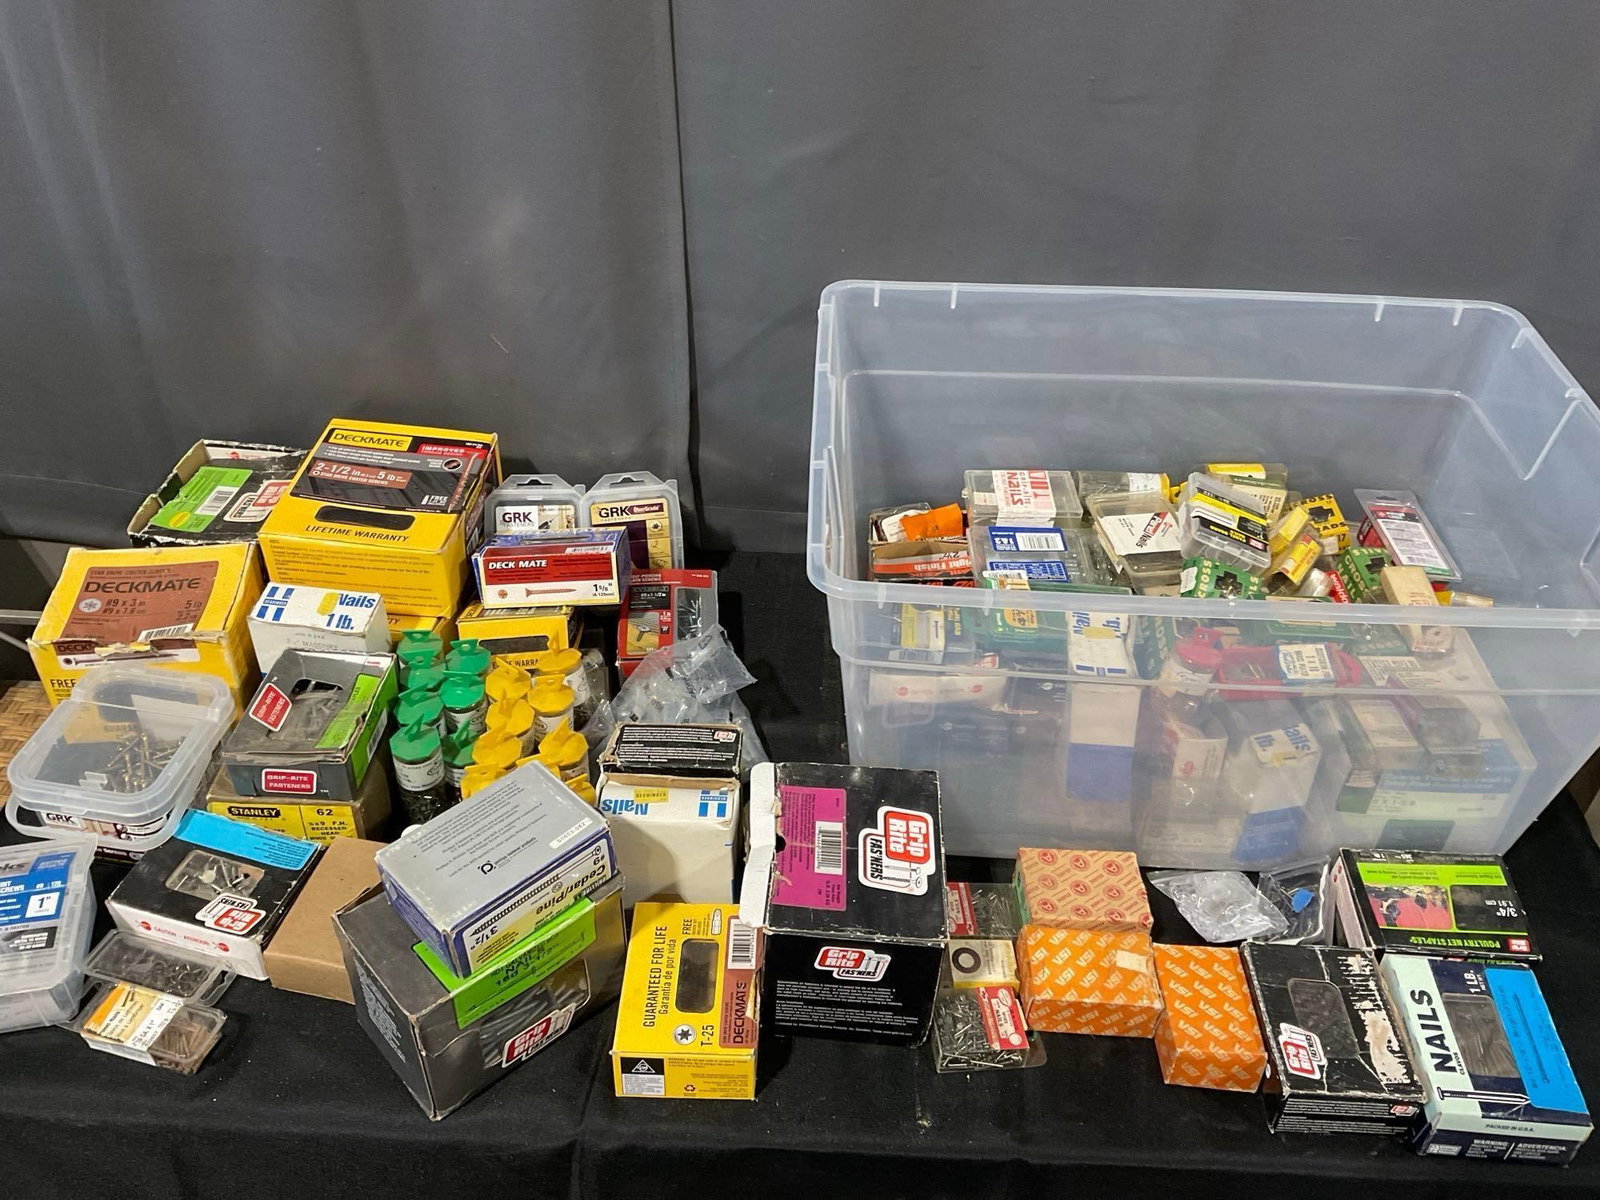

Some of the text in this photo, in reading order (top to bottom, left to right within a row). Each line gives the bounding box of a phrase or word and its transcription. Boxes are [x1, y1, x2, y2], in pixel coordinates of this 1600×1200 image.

[333, 432, 408, 447] DECKMATE
[316, 462, 350, 475] 2-1/2
[377, 470, 385, 479] 5
[502, 512, 532, 523] GRK
[599, 505, 629, 519] GRK
[305, 525, 409, 543] LIFETIME WARRANTY
[488, 559, 547, 570] DECK MATE
[84, 577, 201, 594] DECKMATE
[105, 599, 119, 608] #9
[131, 599, 137, 607] 3
[185, 600, 191, 609] 5
[327, 613, 354, 630] 1 lb.
[58, 643, 97, 653] DECKM
[267, 774, 309, 782] GRIP-RITE
[269, 782, 311, 790] FASTENERS
[230, 808, 279, 817] STANLEY
[317, 808, 334, 816] 62
[602, 798, 649, 816] Nails
[46, 812, 74, 824] GRK
[888, 818, 904, 854] Rite
[909, 819, 926, 857] Grip
[536, 864, 606, 916] Cedar/Pine
[682, 918, 693, 936] FREE
[669, 939, 677, 953] vida
[1410, 936, 1501, 948] POULTRY NET STAPLES
[666, 953, 675, 969] por
[828, 949, 859, 961] Grip
[825, 958, 855, 968] Rite
[643, 926, 668, 1027] GUARANTEED FOR LIFE
[665, 970, 673, 980] de
[514, 1022, 546, 1047] Grip
[700, 1025, 715, 1046] T-25
[1410, 989, 1459, 1074] NAILS
